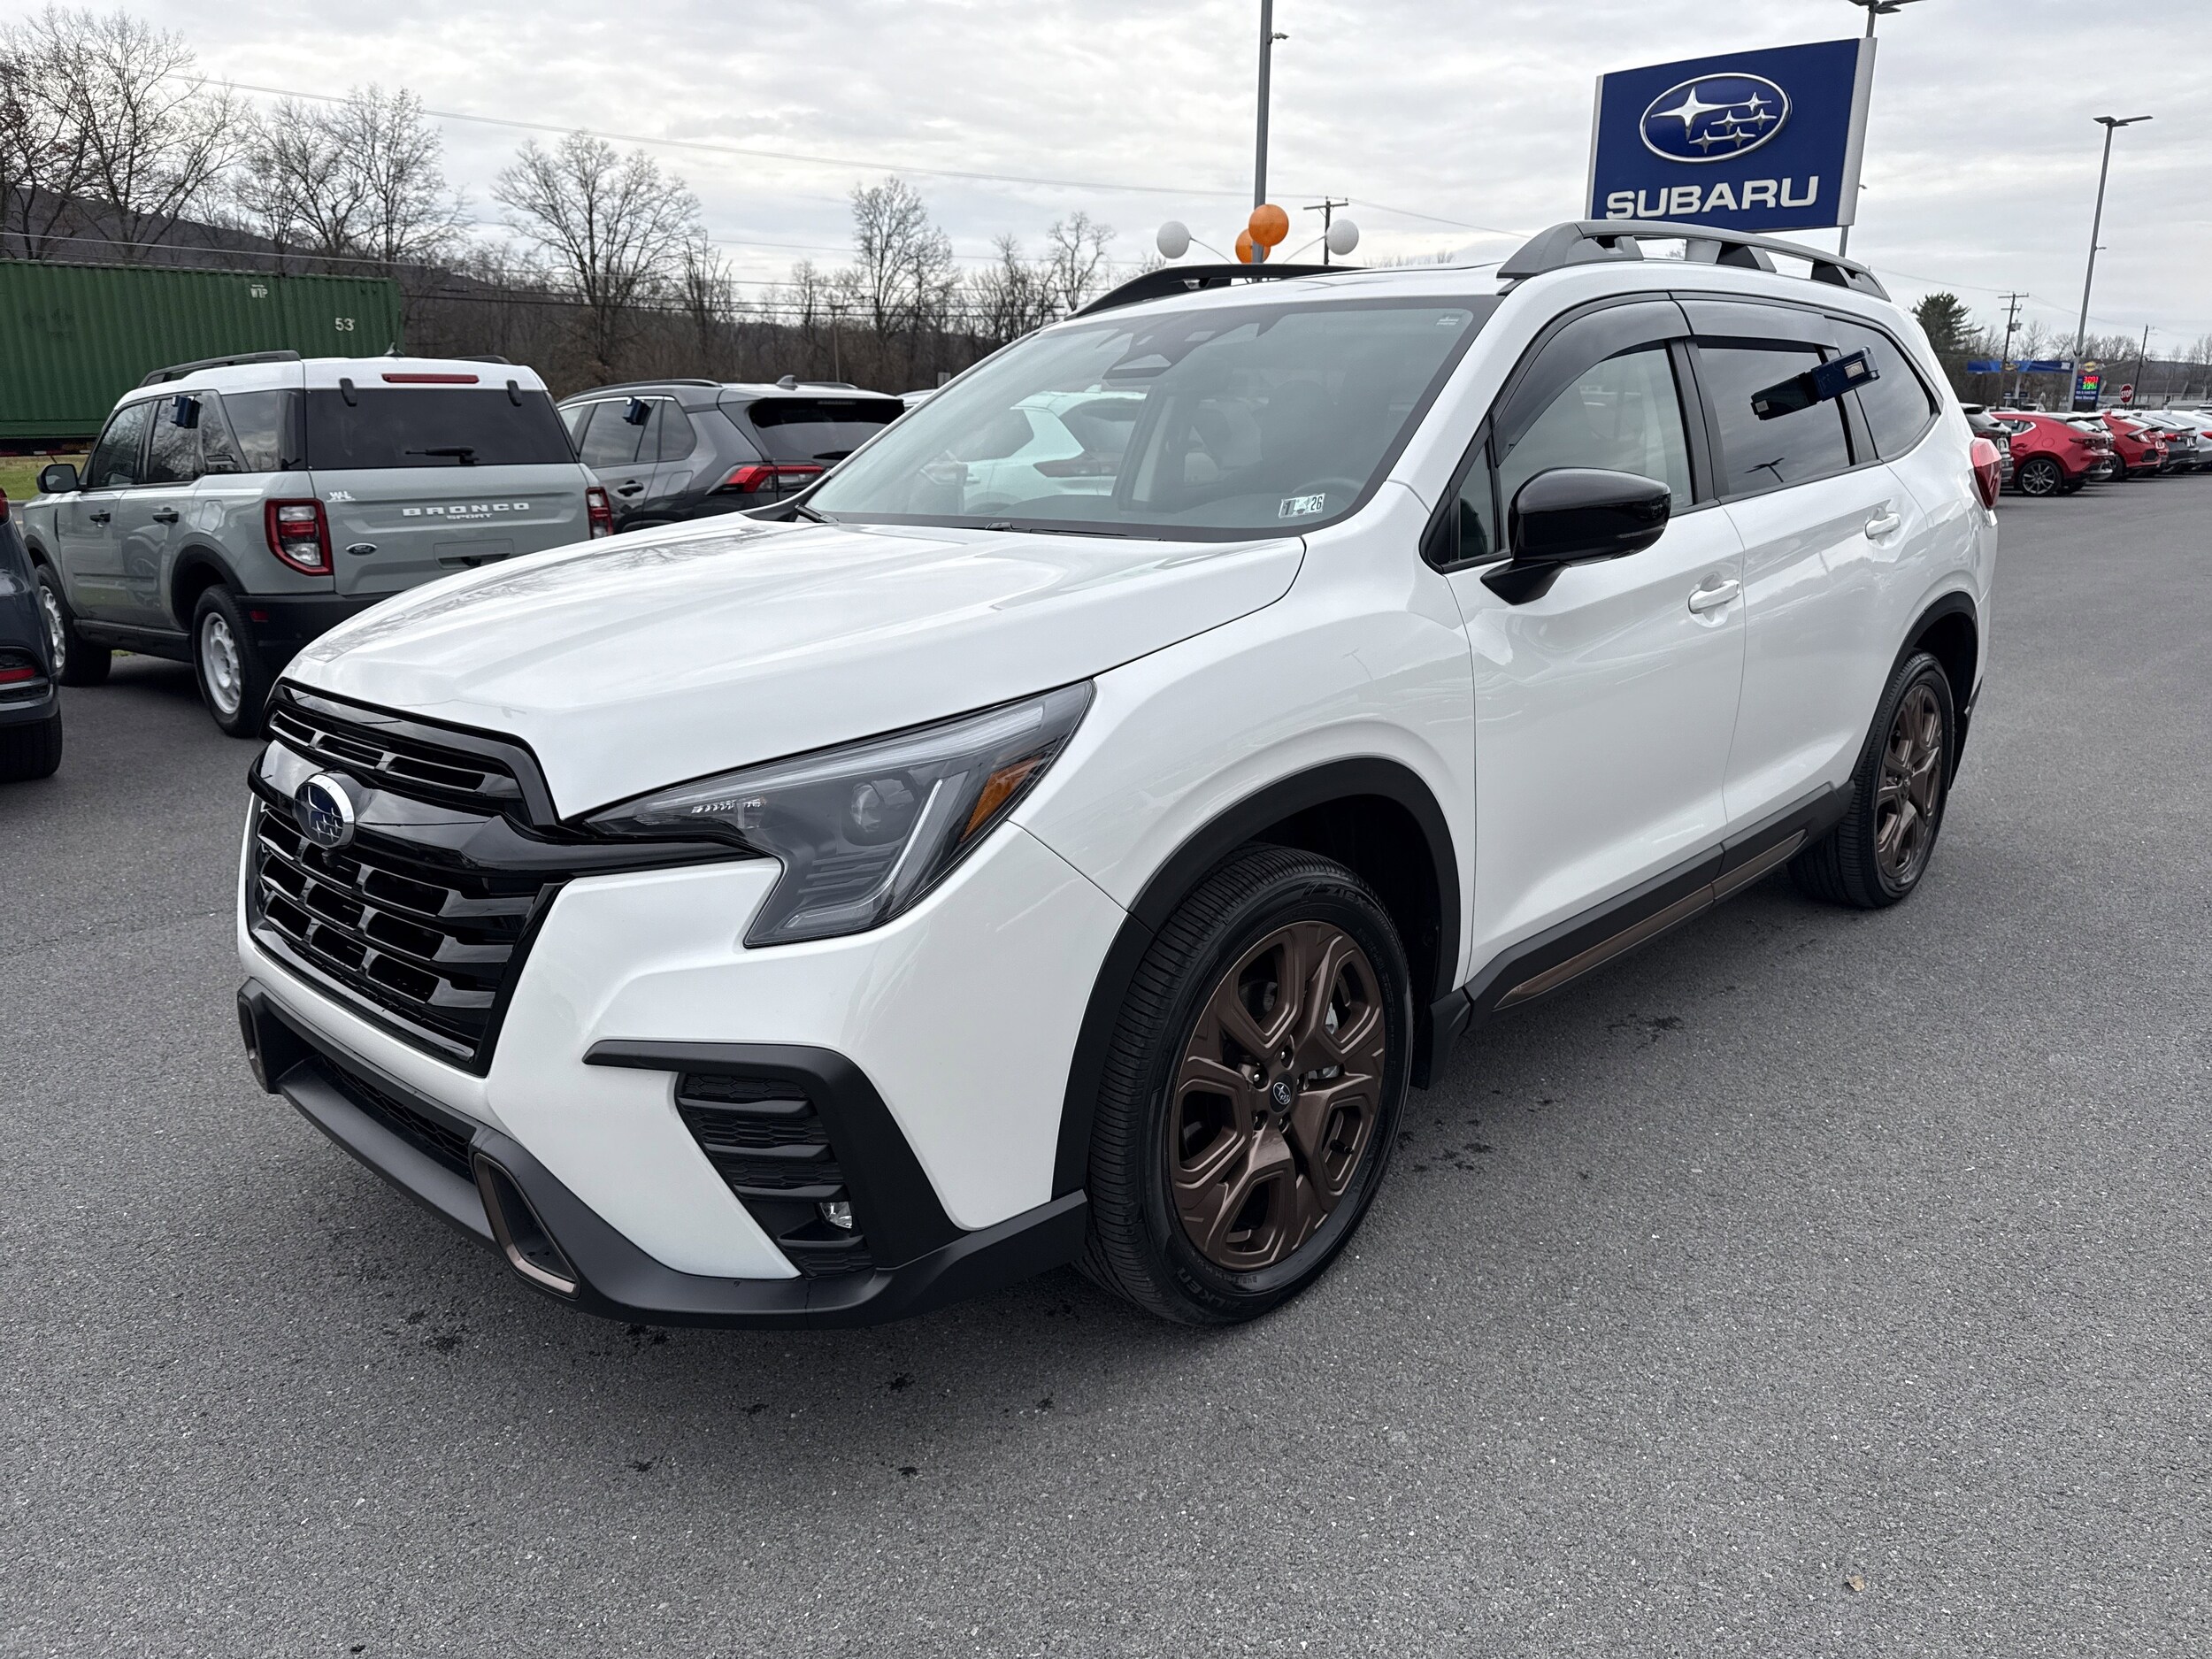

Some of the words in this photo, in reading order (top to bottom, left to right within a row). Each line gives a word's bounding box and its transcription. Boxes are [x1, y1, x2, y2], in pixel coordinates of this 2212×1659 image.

[1606, 176, 1819, 219] SUBARU
[2120, 389, 2132, 399] STOP
[402, 503, 529, 517] BRONCO
[1310, 496, 1323, 511] 26
[1326, 886, 1367, 908] ZIEX
[1176, 1267, 1253, 1310] ALKEN
